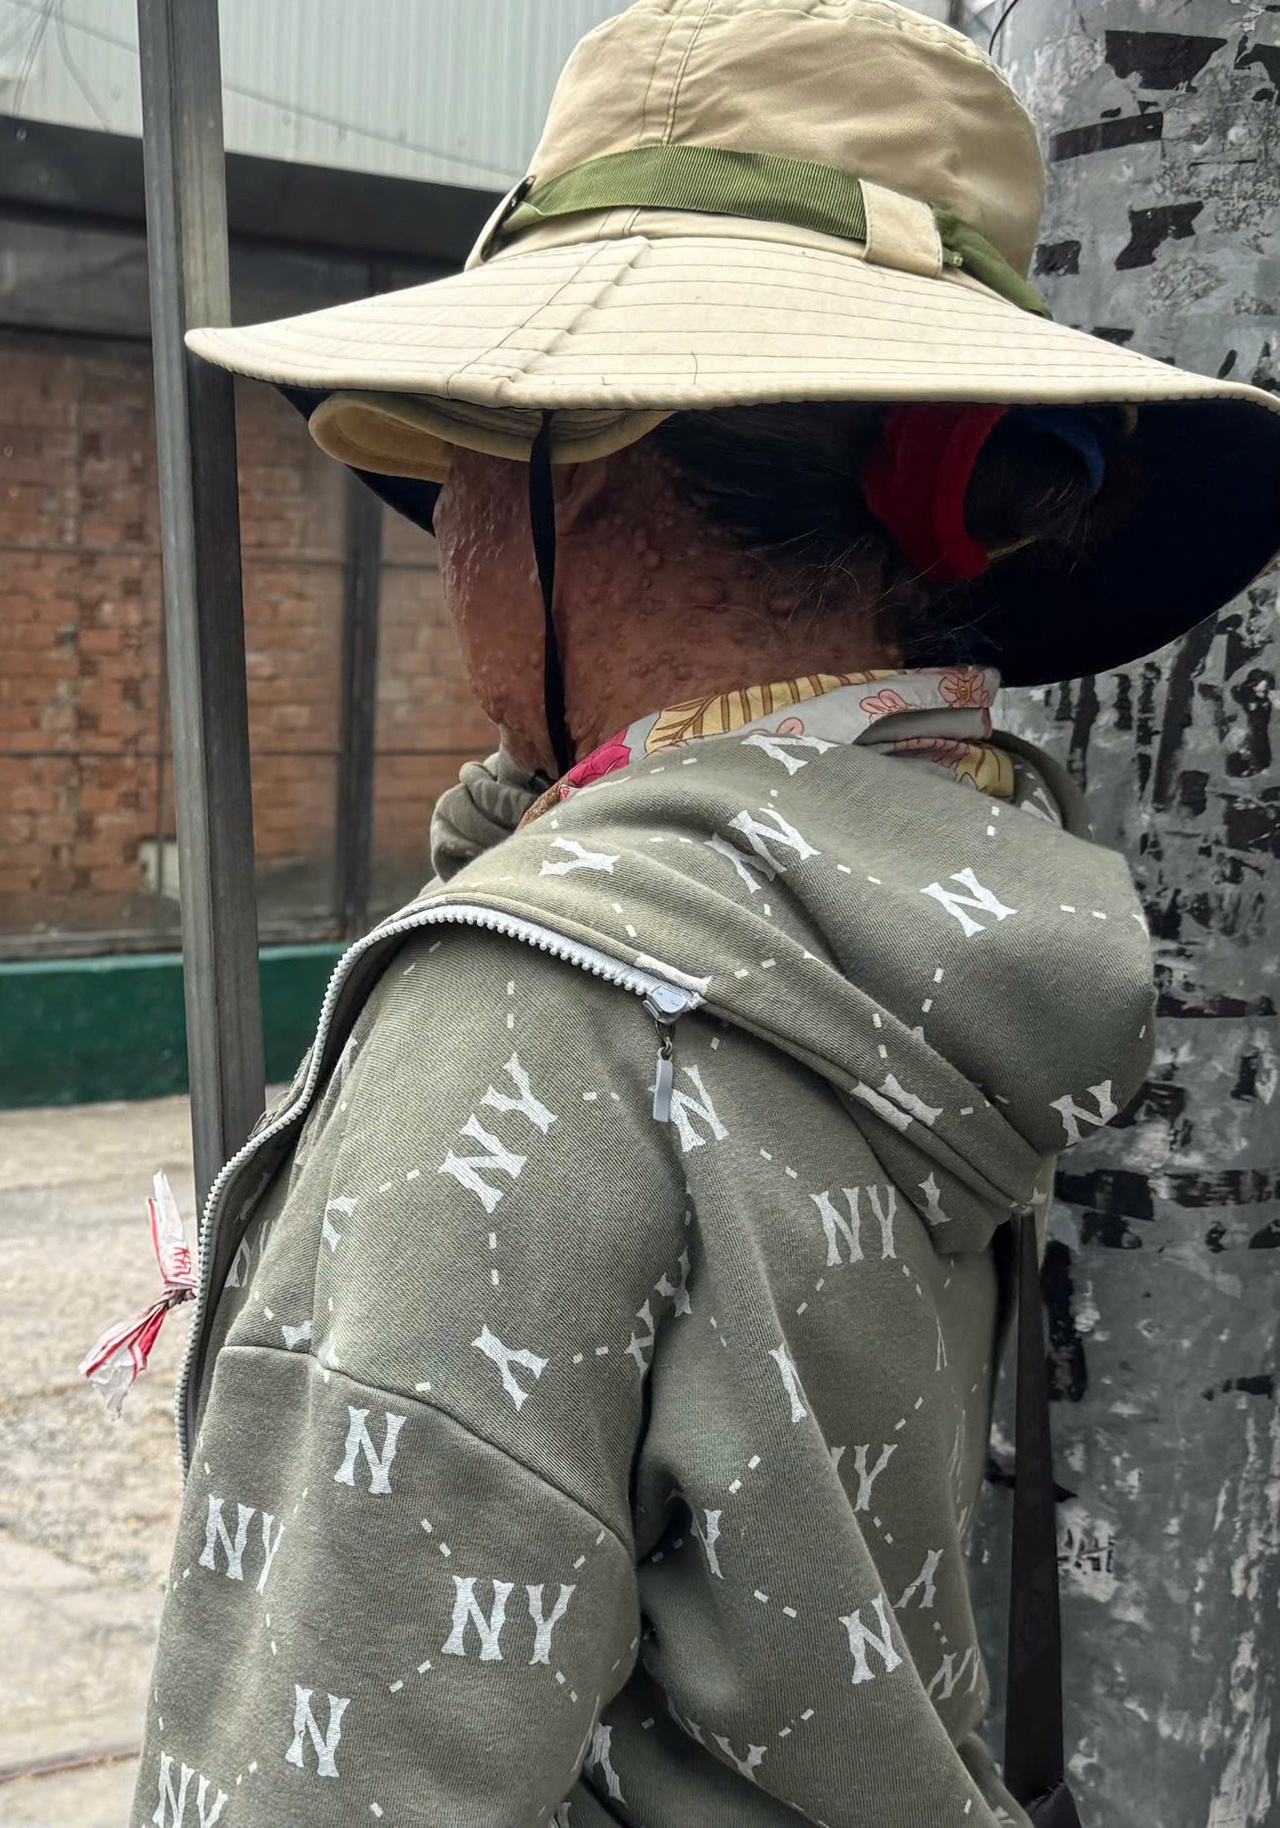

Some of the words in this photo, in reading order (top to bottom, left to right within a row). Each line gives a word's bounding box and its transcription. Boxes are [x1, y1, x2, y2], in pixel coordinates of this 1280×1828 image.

[539, 837, 620, 876] Y
[920, 867, 1018, 937] N
[437, 1052, 558, 1213] NY
[1049, 1079, 1118, 1147] N
[808, 1184, 896, 1266] NY
[472, 1325, 549, 1410] Y
[334, 1405, 407, 1494] N
[198, 1493, 286, 1596] NY
[441, 1575, 576, 1665] NY
[838, 1592, 903, 1684] N
[285, 1684, 351, 1778] N
